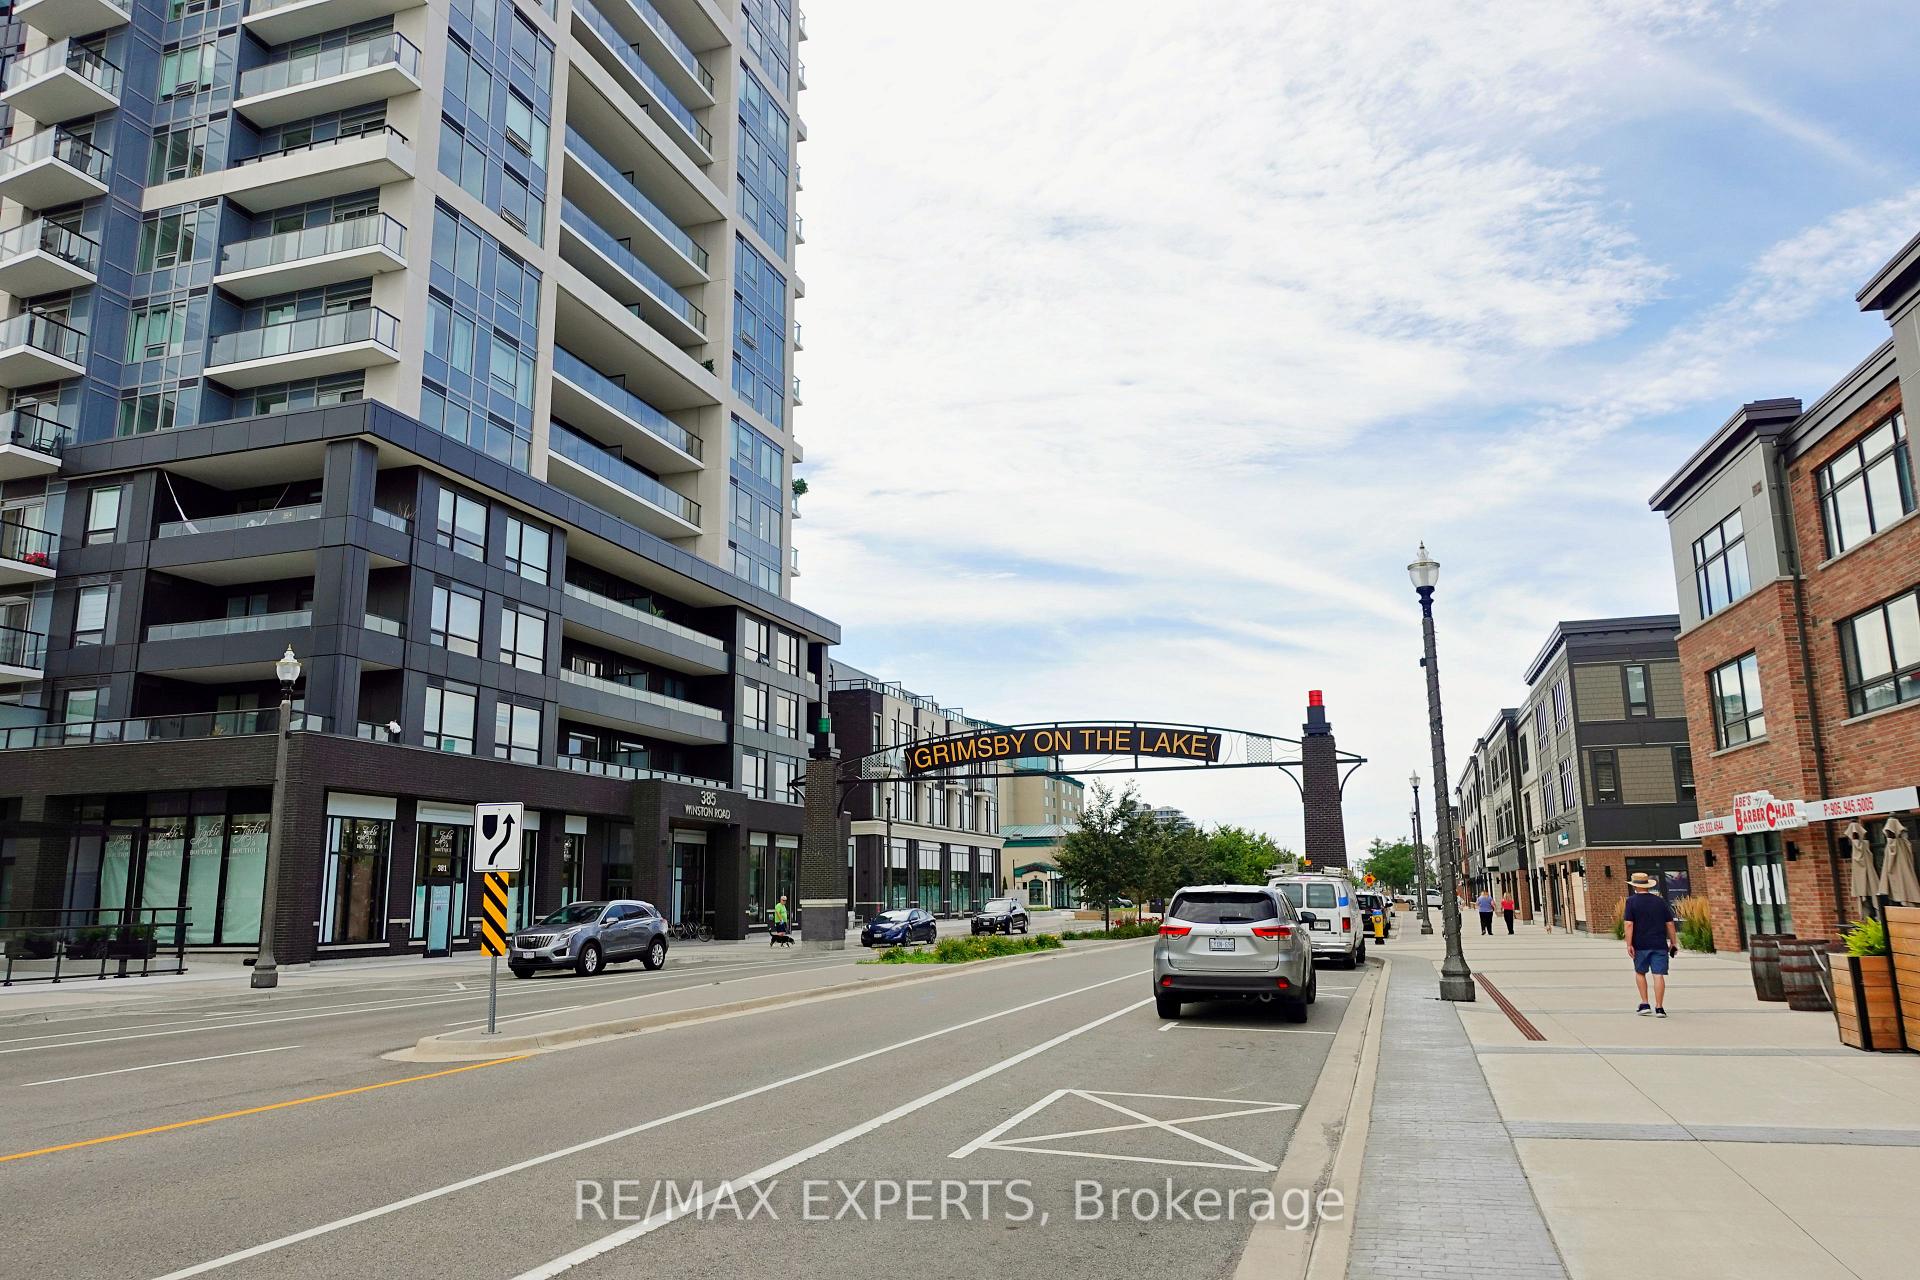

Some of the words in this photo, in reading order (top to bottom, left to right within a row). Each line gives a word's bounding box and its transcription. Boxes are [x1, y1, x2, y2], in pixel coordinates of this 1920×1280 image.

[914, 732, 1026, 768] GRIMSBY
[1034, 730, 1071, 752] ON
[1079, 729, 1131, 751] THE
[1140, 730, 1209, 757] LAKE
[700, 790, 717, 806] 385
[685, 803, 714, 818] WINSTON
[714, 808, 731, 820] ROAD
[1734, 807, 1766, 832] BARBER
[1766, 801, 1796, 829] CHAIR
[437, 864, 447, 872] 381
[1741, 863, 1787, 906] OPEN
